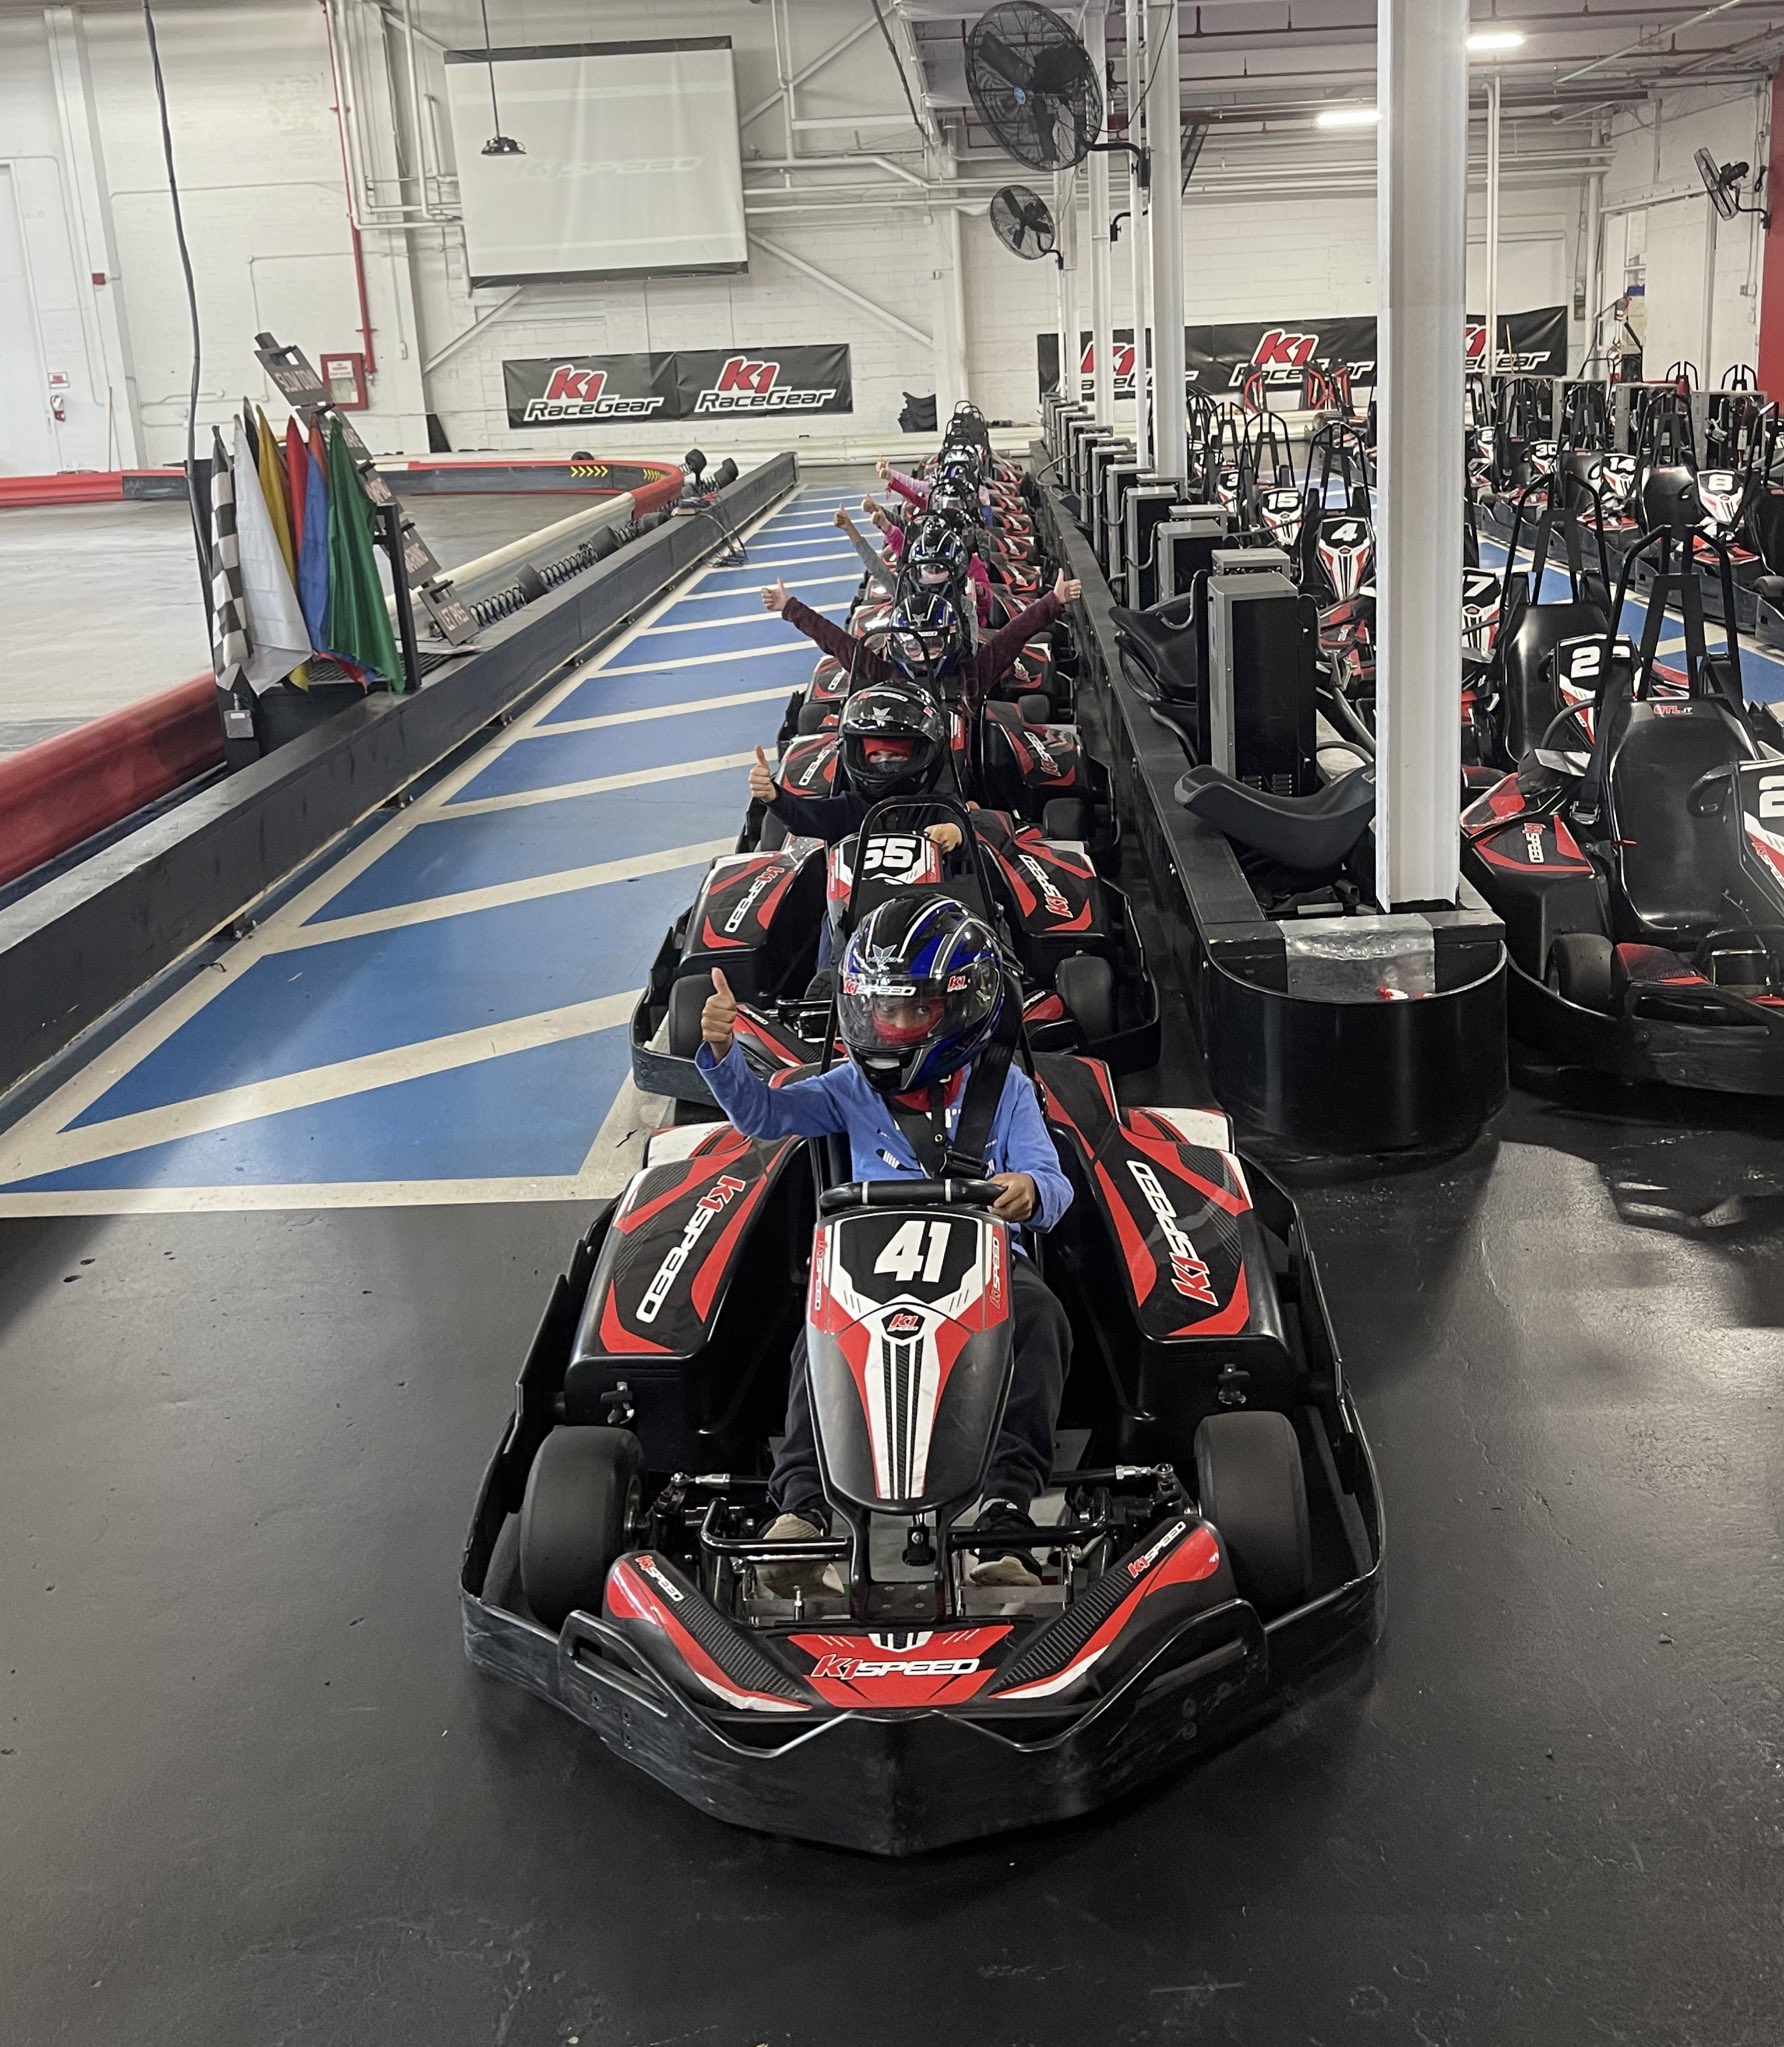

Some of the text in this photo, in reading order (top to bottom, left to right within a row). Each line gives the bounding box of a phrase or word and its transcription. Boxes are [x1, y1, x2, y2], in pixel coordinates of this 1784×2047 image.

[1250, 328, 1319, 367] K1
[545, 364, 607, 402] K1
[716, 355, 780, 396] K1
[523, 394, 665, 422] RaceGear
[693, 386, 837, 414] RaceGear
[1609, 457, 1636, 471] 14
[1708, 474, 1733, 491] 8
[1267, 493, 1299, 509] 15
[1330, 522, 1358, 542] 4
[636, 1175, 746, 1323] K1SPEED
[1126, 1160, 1219, 1307] K1SPEED
[873, 1220, 952, 1283] 41
[1127, 1521, 1187, 1579] K1SPEED
[811, 1654, 980, 1680] K1SPEED
